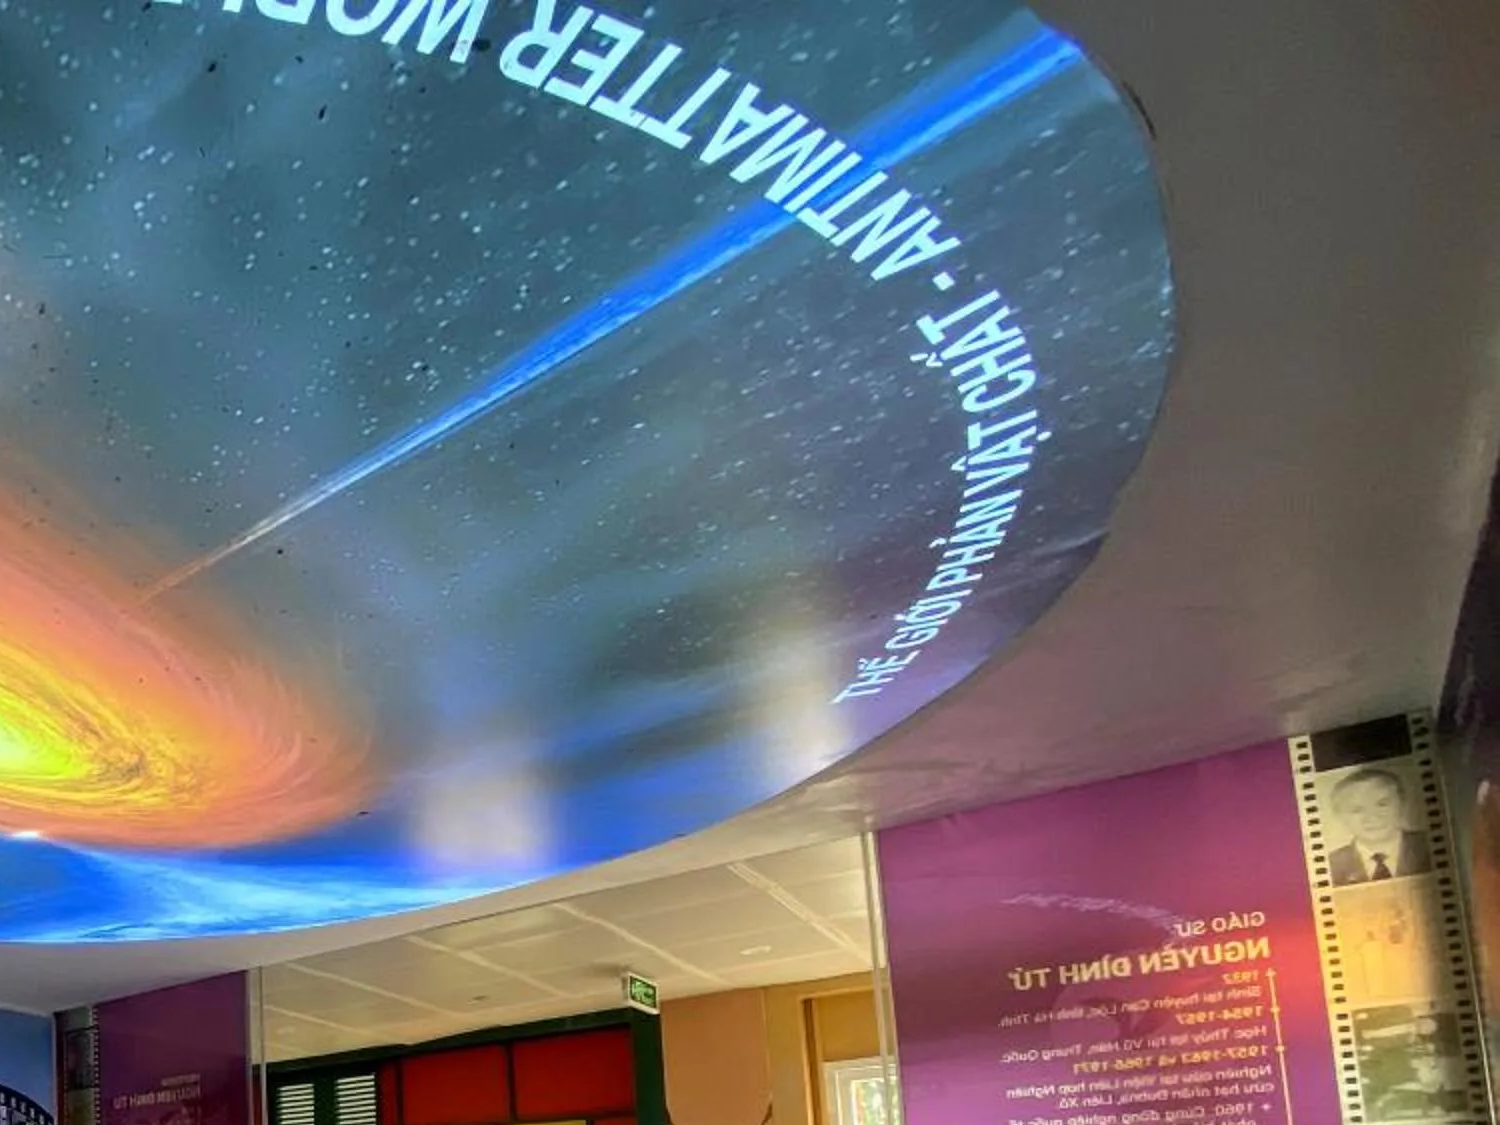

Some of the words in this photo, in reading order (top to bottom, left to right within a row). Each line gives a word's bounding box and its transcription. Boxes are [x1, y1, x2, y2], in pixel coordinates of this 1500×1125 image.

[499, 0, 961, 280] ANTIMATTER
[910, 289, 1036, 413] CHẤT
[951, 410, 1052, 497] VẬT
[926, 489, 1024, 590] PHẢN
[885, 589, 972, 650] GIỚI
[832, 650, 922, 703] THẾ
